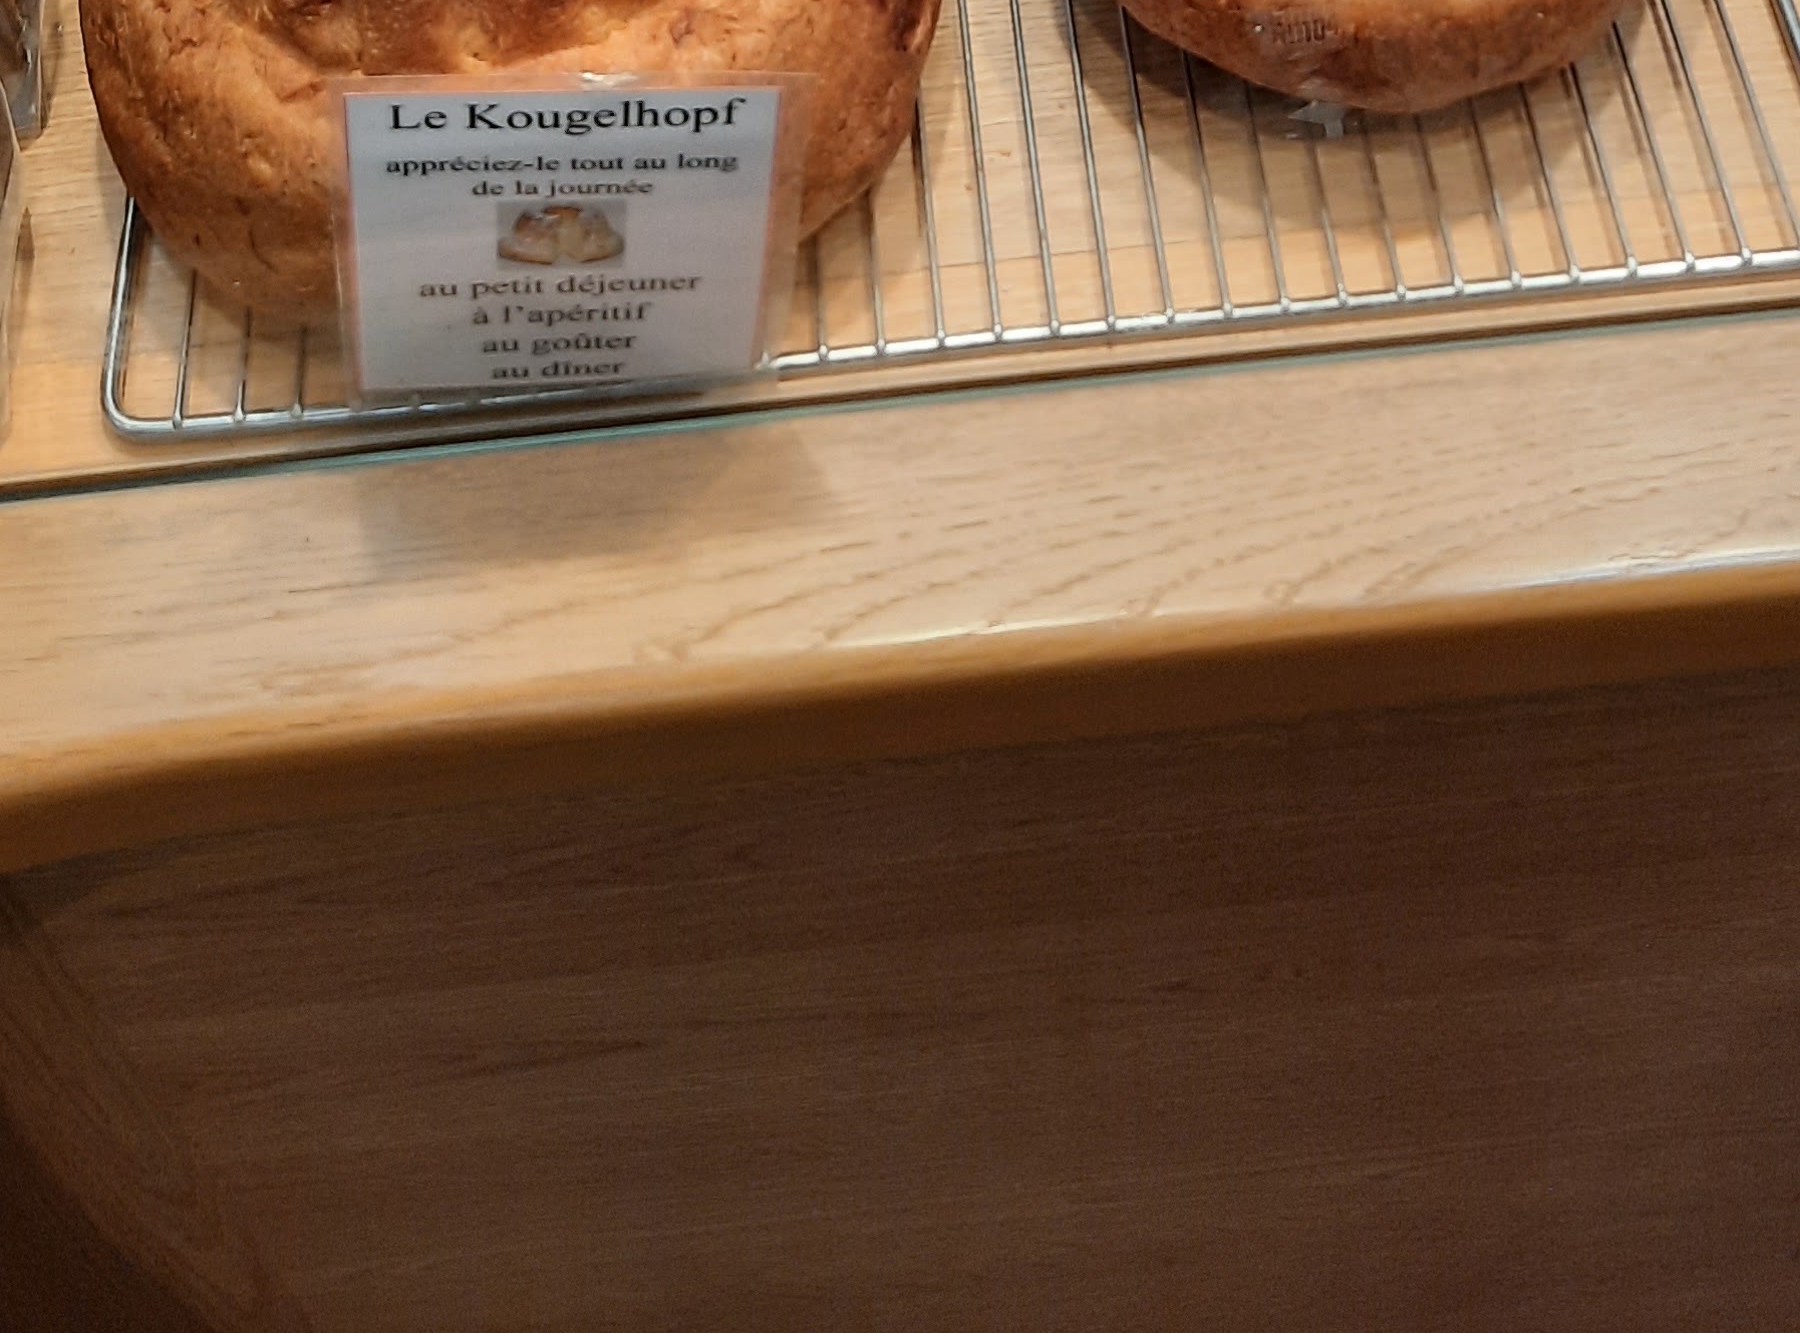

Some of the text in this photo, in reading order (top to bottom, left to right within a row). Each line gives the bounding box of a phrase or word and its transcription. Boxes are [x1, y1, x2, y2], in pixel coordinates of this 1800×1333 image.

[390, 97, 746, 134] Le Kougelhopf
[386, 153, 738, 174] appréciez-le tout au long
[472, 178, 653, 196] de la journée
[419, 275, 701, 299] au petit déjeuner
[473, 306, 489, 325] à
[482, 333, 637, 355] au goûter
[491, 364, 528, 379] au
